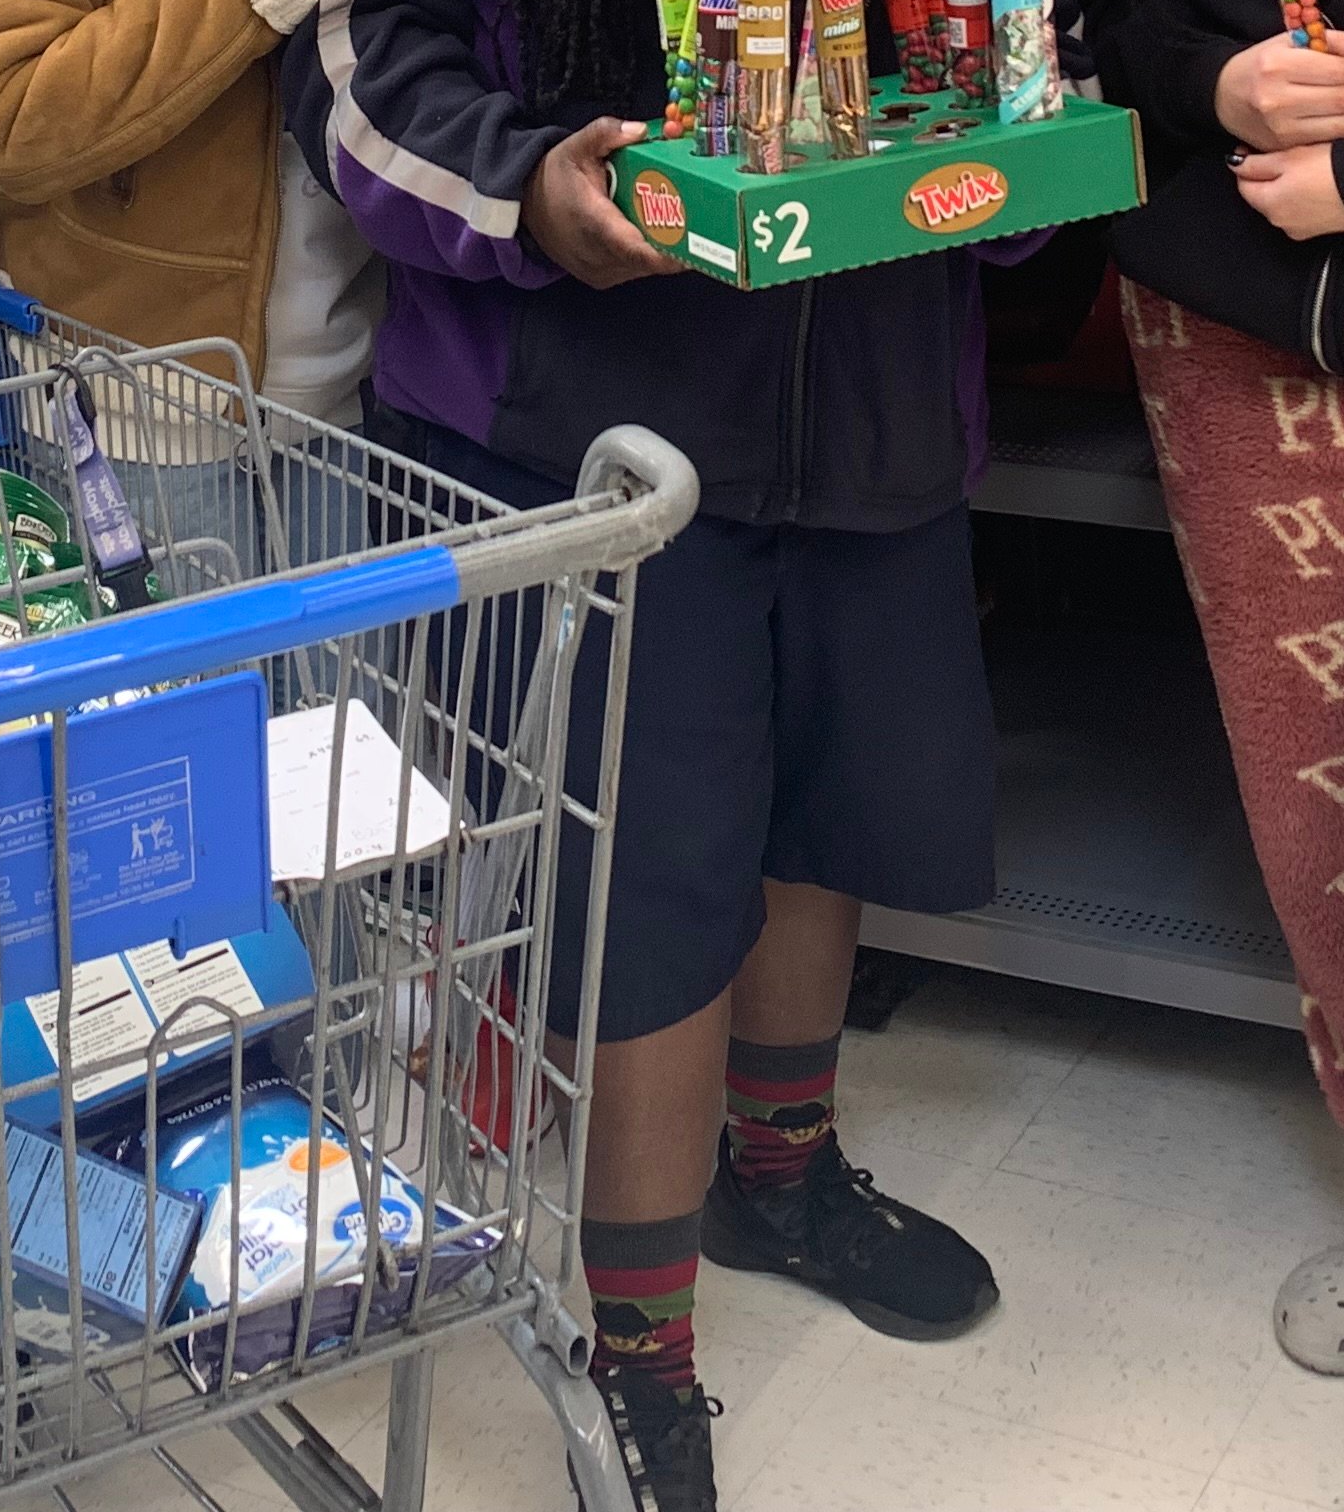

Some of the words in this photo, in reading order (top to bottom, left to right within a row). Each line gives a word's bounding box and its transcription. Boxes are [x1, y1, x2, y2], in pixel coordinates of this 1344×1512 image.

[635, 181, 686, 230] Twix
[910, 170, 1008, 228] Twix
[751, 201, 813, 266] $2
